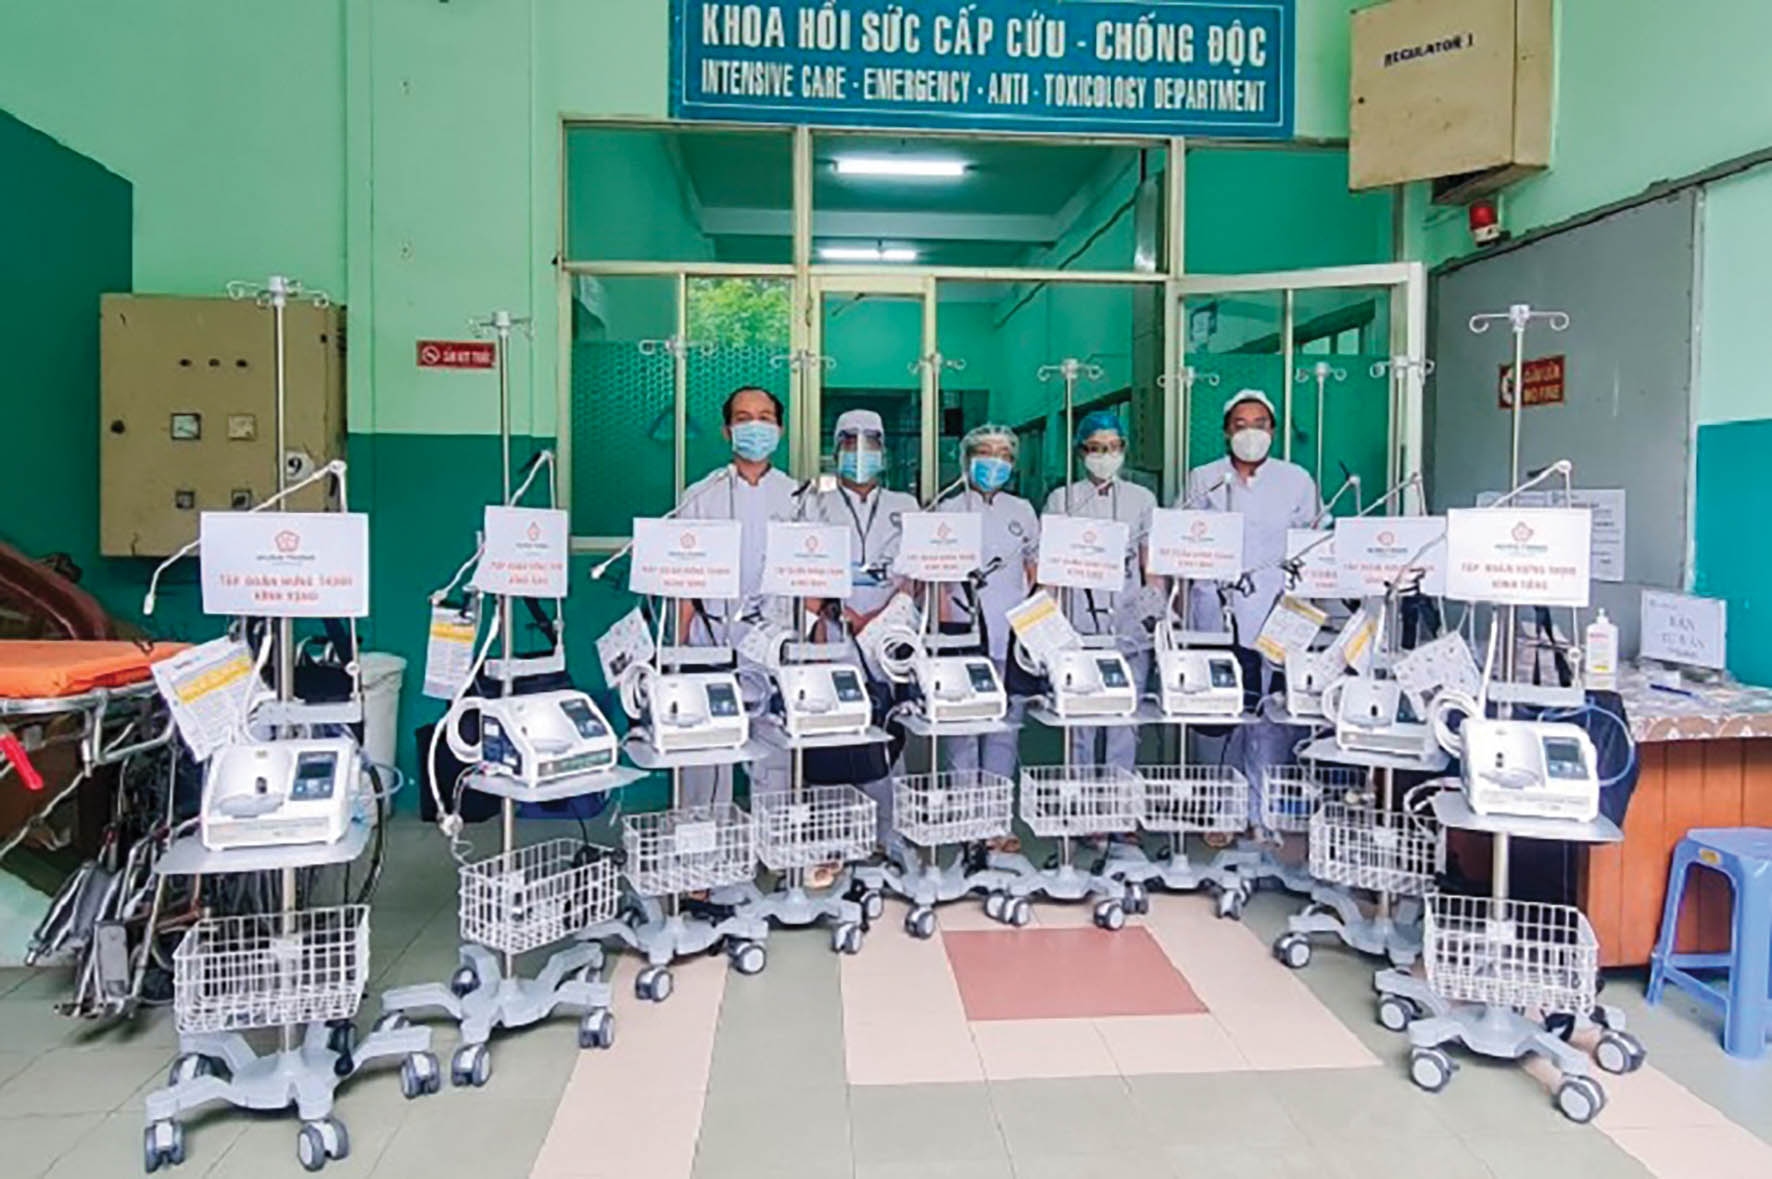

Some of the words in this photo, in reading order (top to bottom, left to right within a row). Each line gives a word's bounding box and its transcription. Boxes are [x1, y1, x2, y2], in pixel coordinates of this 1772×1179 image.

[702, 3, 785, 48] KHOA
[862, 4, 920, 53] SỨC
[934, 4, 994, 56] CẤP
[1006, 9, 1066, 58] CỨU
[1095, 11, 1194, 63] CHỐNG
[1207, 19, 1267, 75] ĐỘC
[1383, 35, 1462, 67] REGULATOR
[701, 58, 794, 97] INTENSIVE
[801, 65, 846, 99] CARE
[863, 67, 971, 104] EMERGENCY
[988, 73, 1029, 105] ANTI
[1043, 73, 1147, 109] TOXICOLOGY
[1154, 77, 1267, 112] DEPARTMENT
[288, 456, 303, 478] 9
